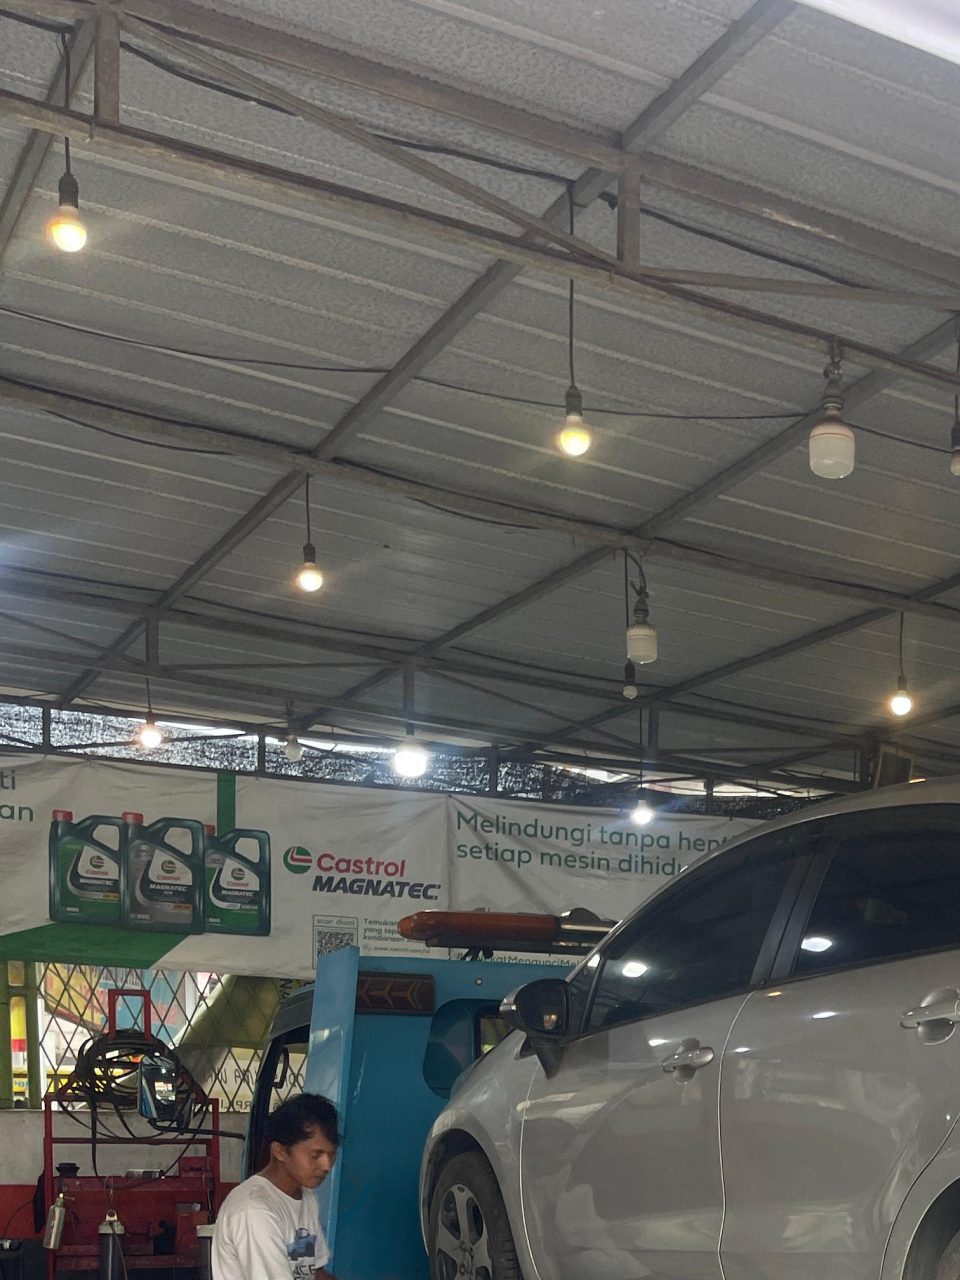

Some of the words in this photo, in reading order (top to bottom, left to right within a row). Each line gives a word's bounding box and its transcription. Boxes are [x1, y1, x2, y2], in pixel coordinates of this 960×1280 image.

[457, 810, 591, 848] Melindungi
[599, 825, 670, 851] tanpa
[679, 831, 735, 852] hen
[317, 852, 406, 877] Castrol
[457, 842, 532, 868] setiap
[540, 850, 610, 872] mesin
[312, 875, 441, 900] MAGNATEC
